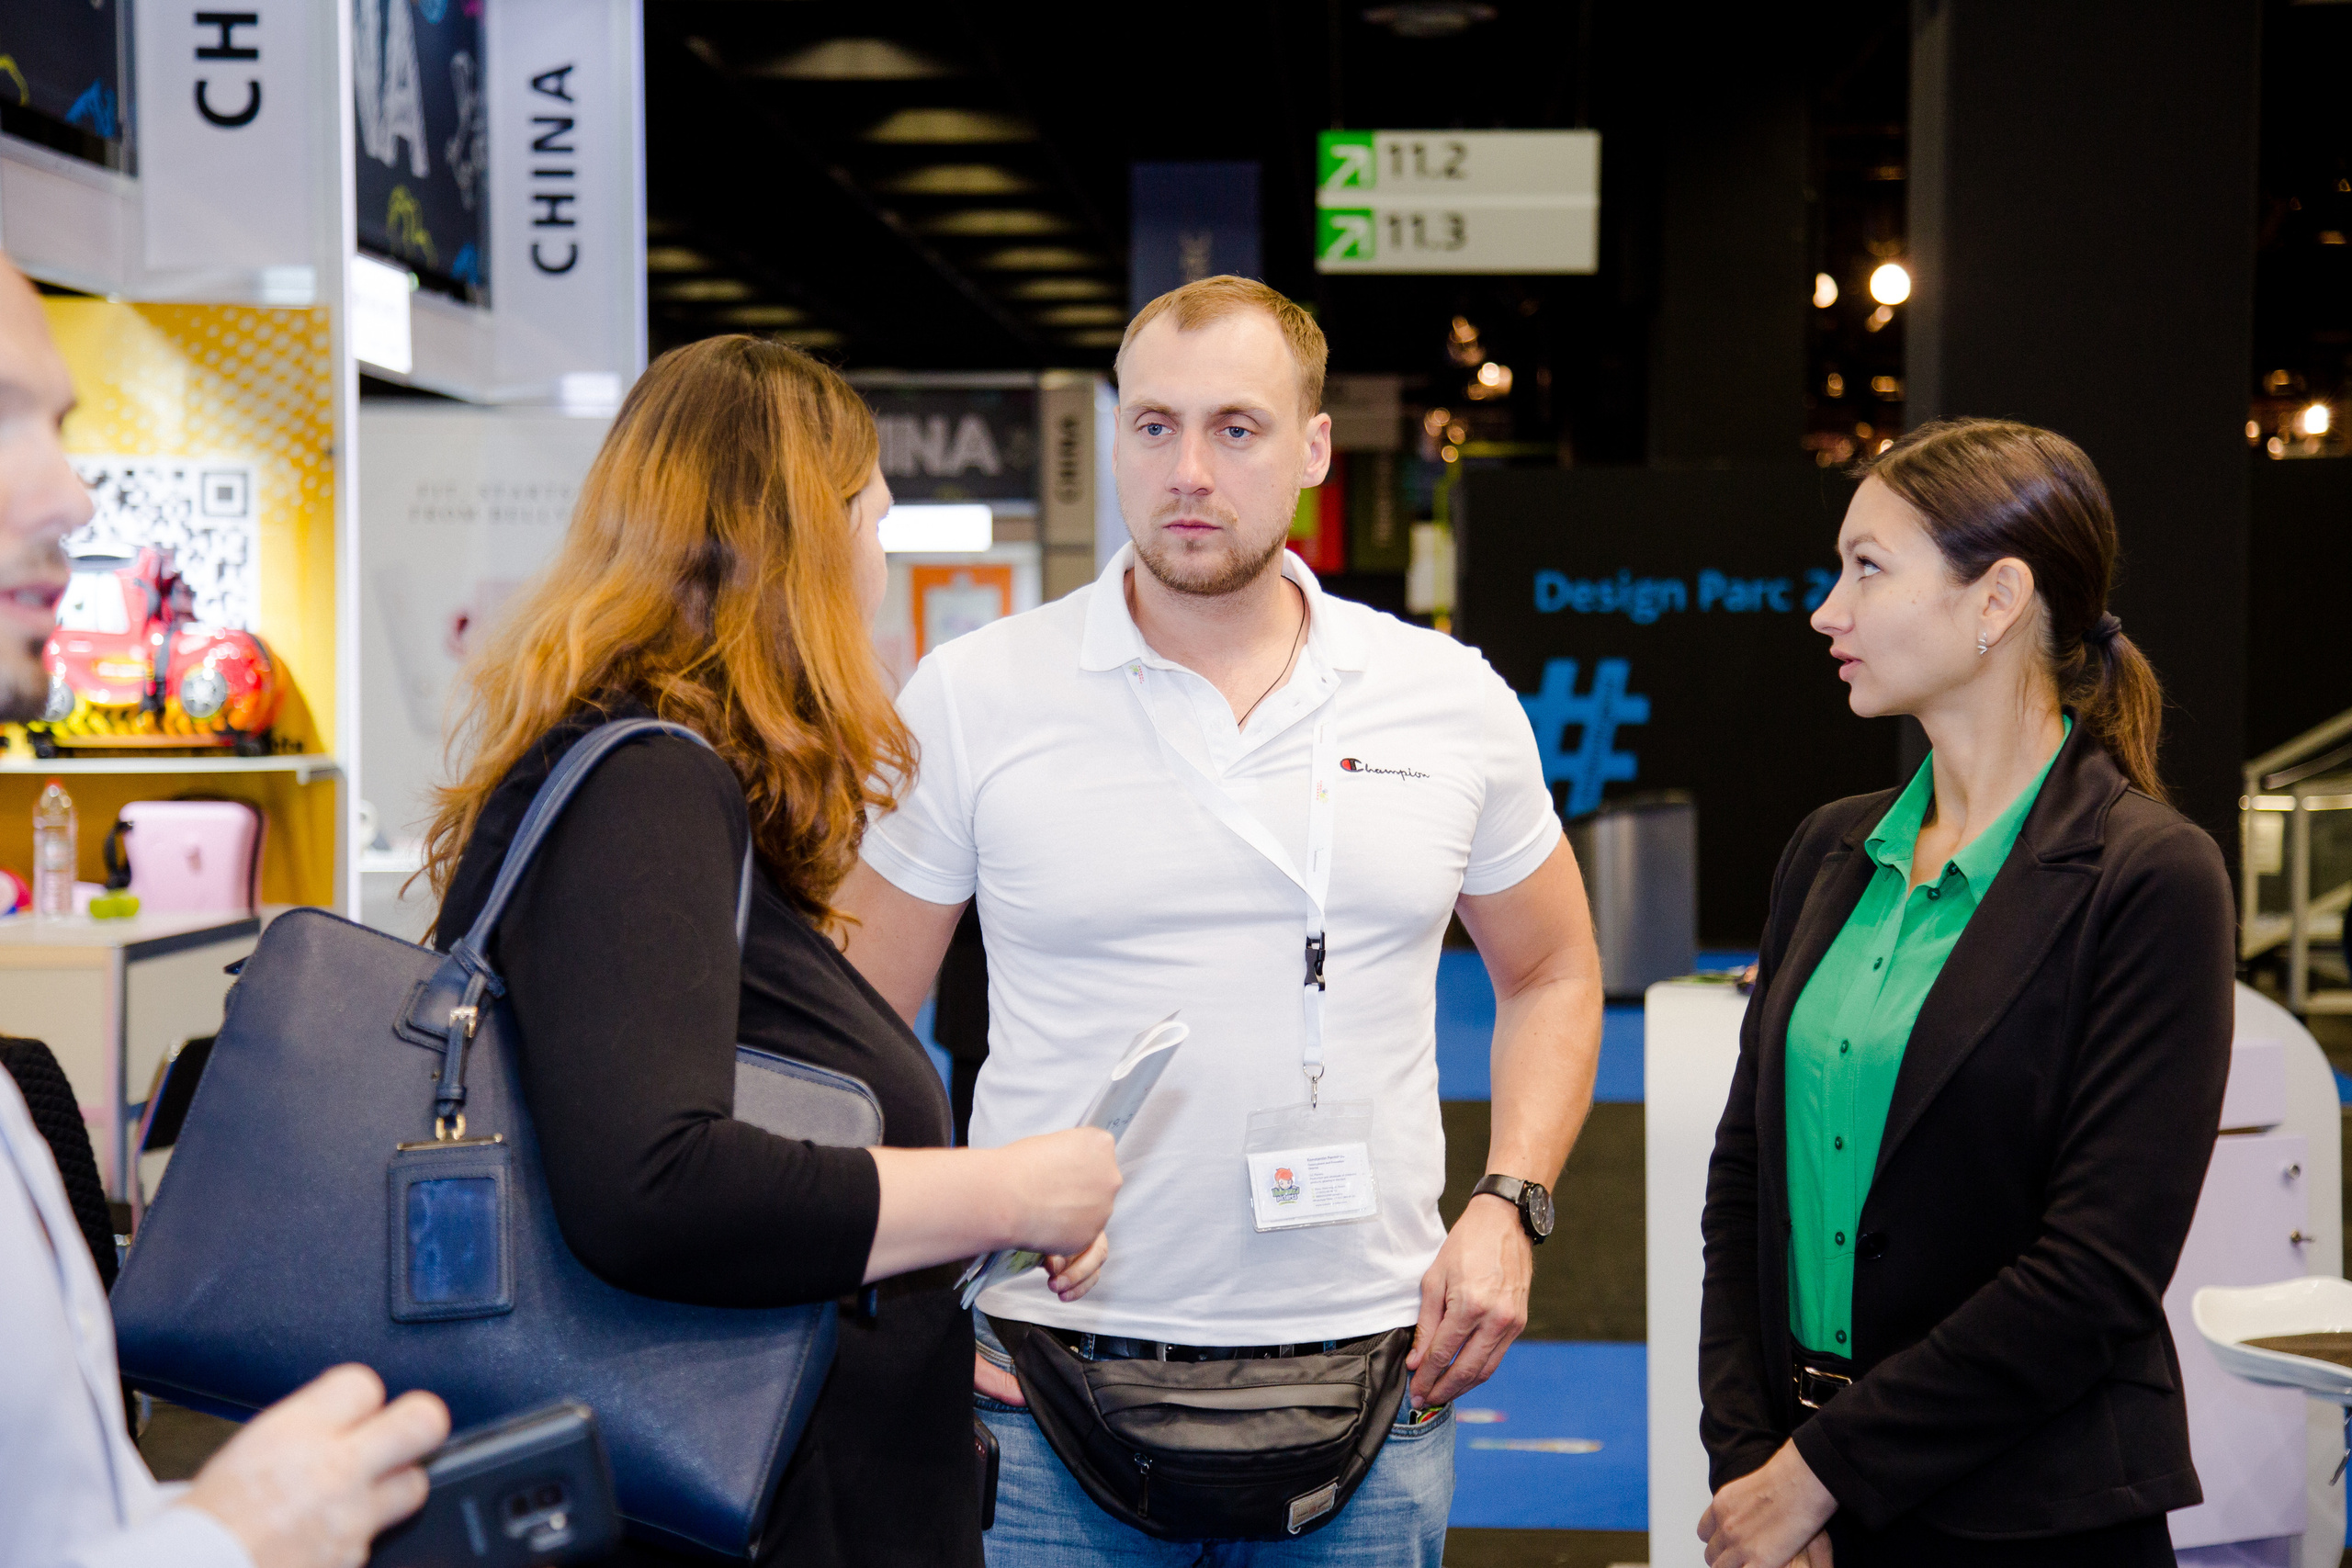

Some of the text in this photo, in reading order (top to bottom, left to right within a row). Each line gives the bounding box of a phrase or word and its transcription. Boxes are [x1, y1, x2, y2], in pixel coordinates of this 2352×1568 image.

[530, 63, 578, 275] CHINA
[1387, 141, 1469, 181] 11.2
[1386, 212, 1466, 251] 11.3
[1533, 567, 1689, 625] Design
[1696, 567, 1793, 613] Parc
[1340, 758, 1430, 781] Champion
